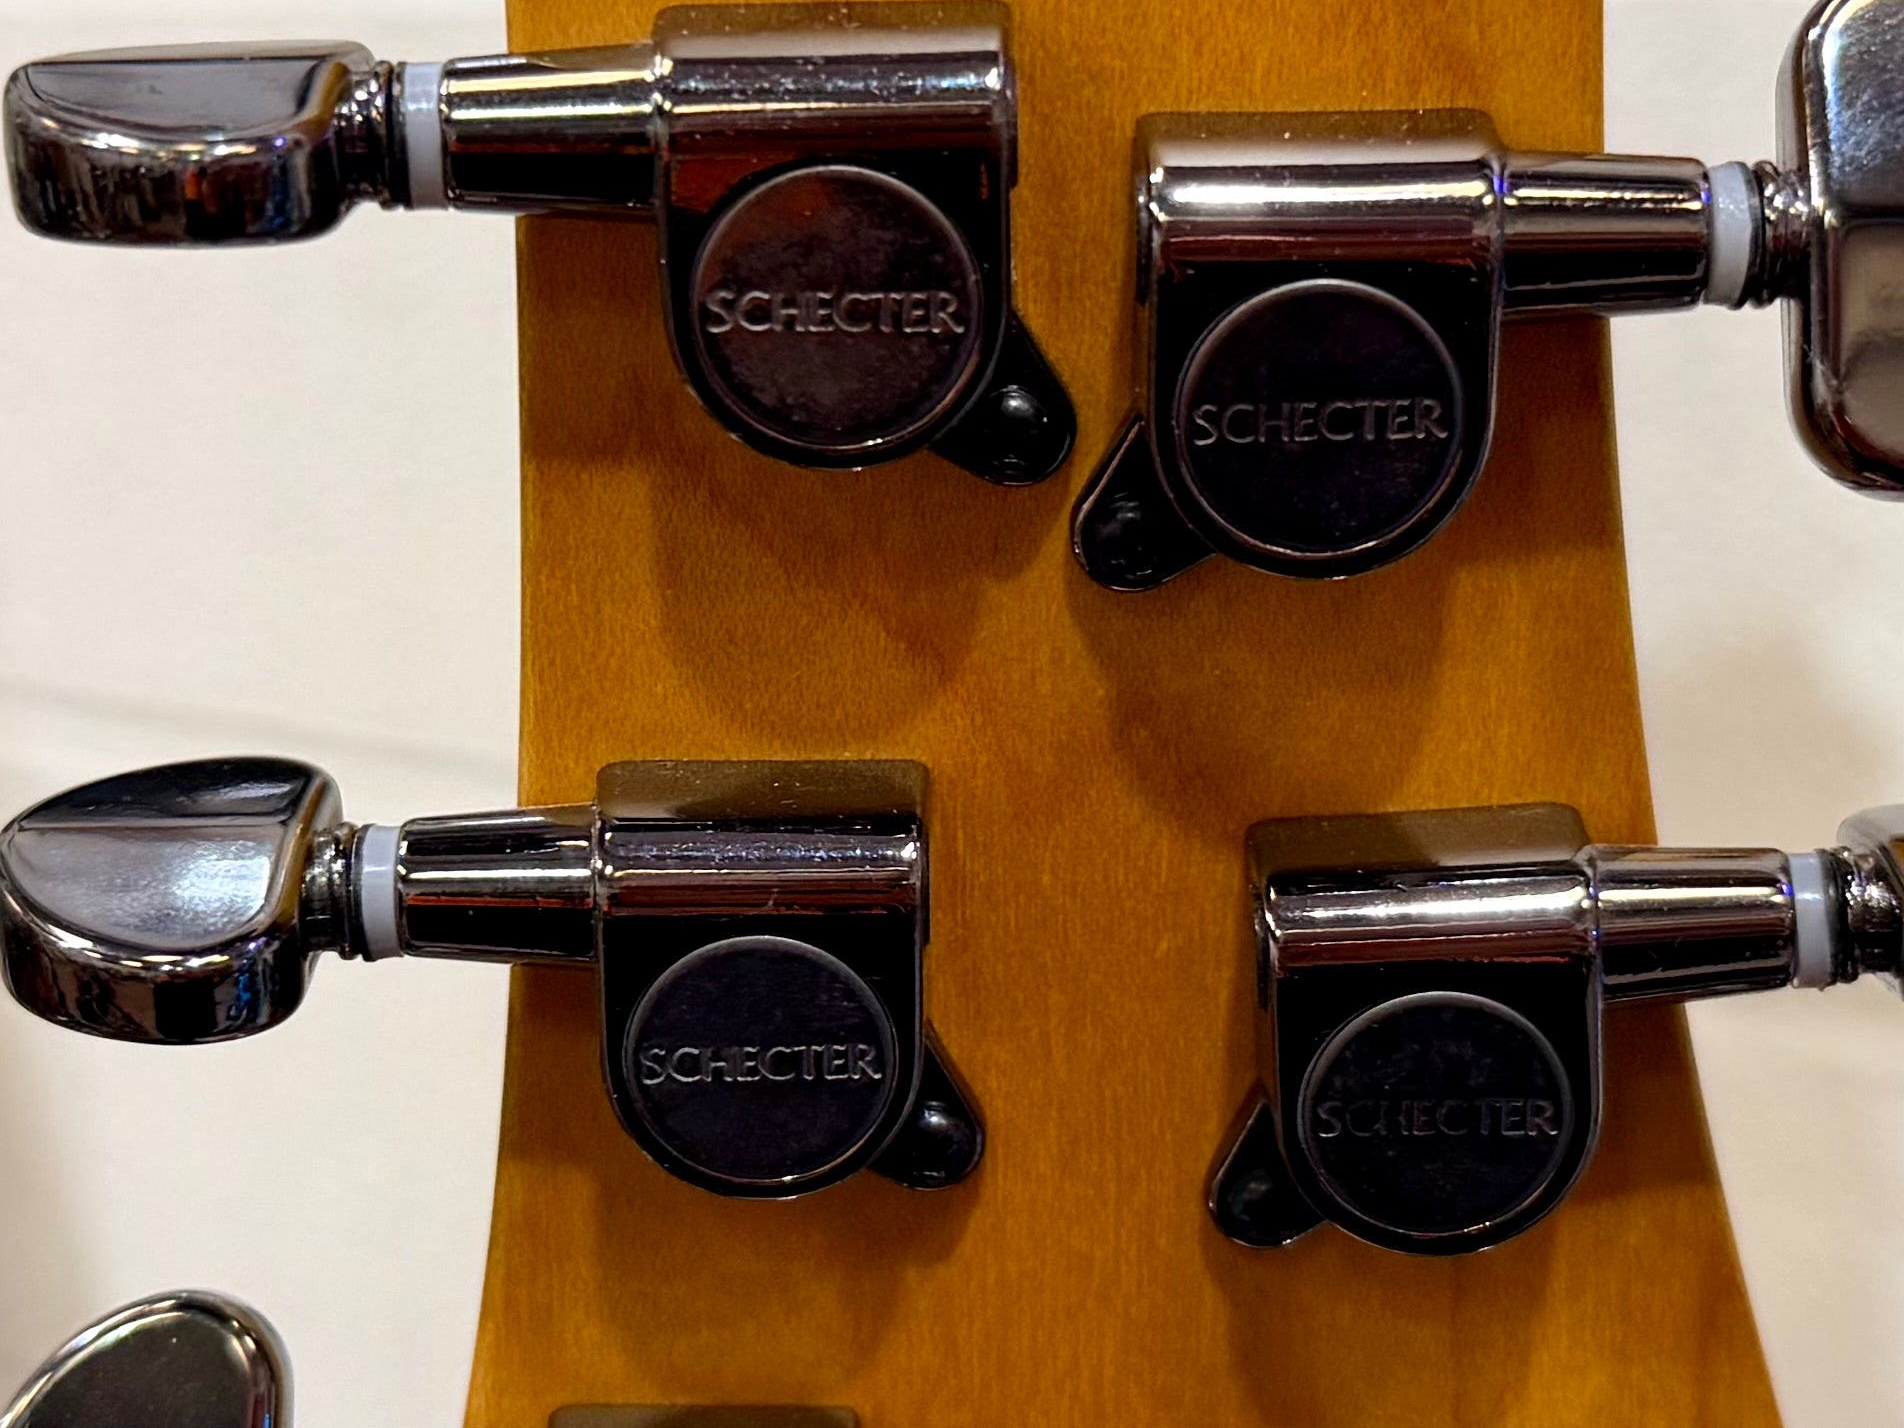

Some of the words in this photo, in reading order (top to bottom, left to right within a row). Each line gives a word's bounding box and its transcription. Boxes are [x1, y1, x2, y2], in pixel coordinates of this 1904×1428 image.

[704, 290, 965, 334] SCHECTER
[1192, 397, 1449, 447] SCHECTER
[639, 1045, 883, 1085] SCHECTER
[1316, 1099, 1559, 1138] SCHECTER
